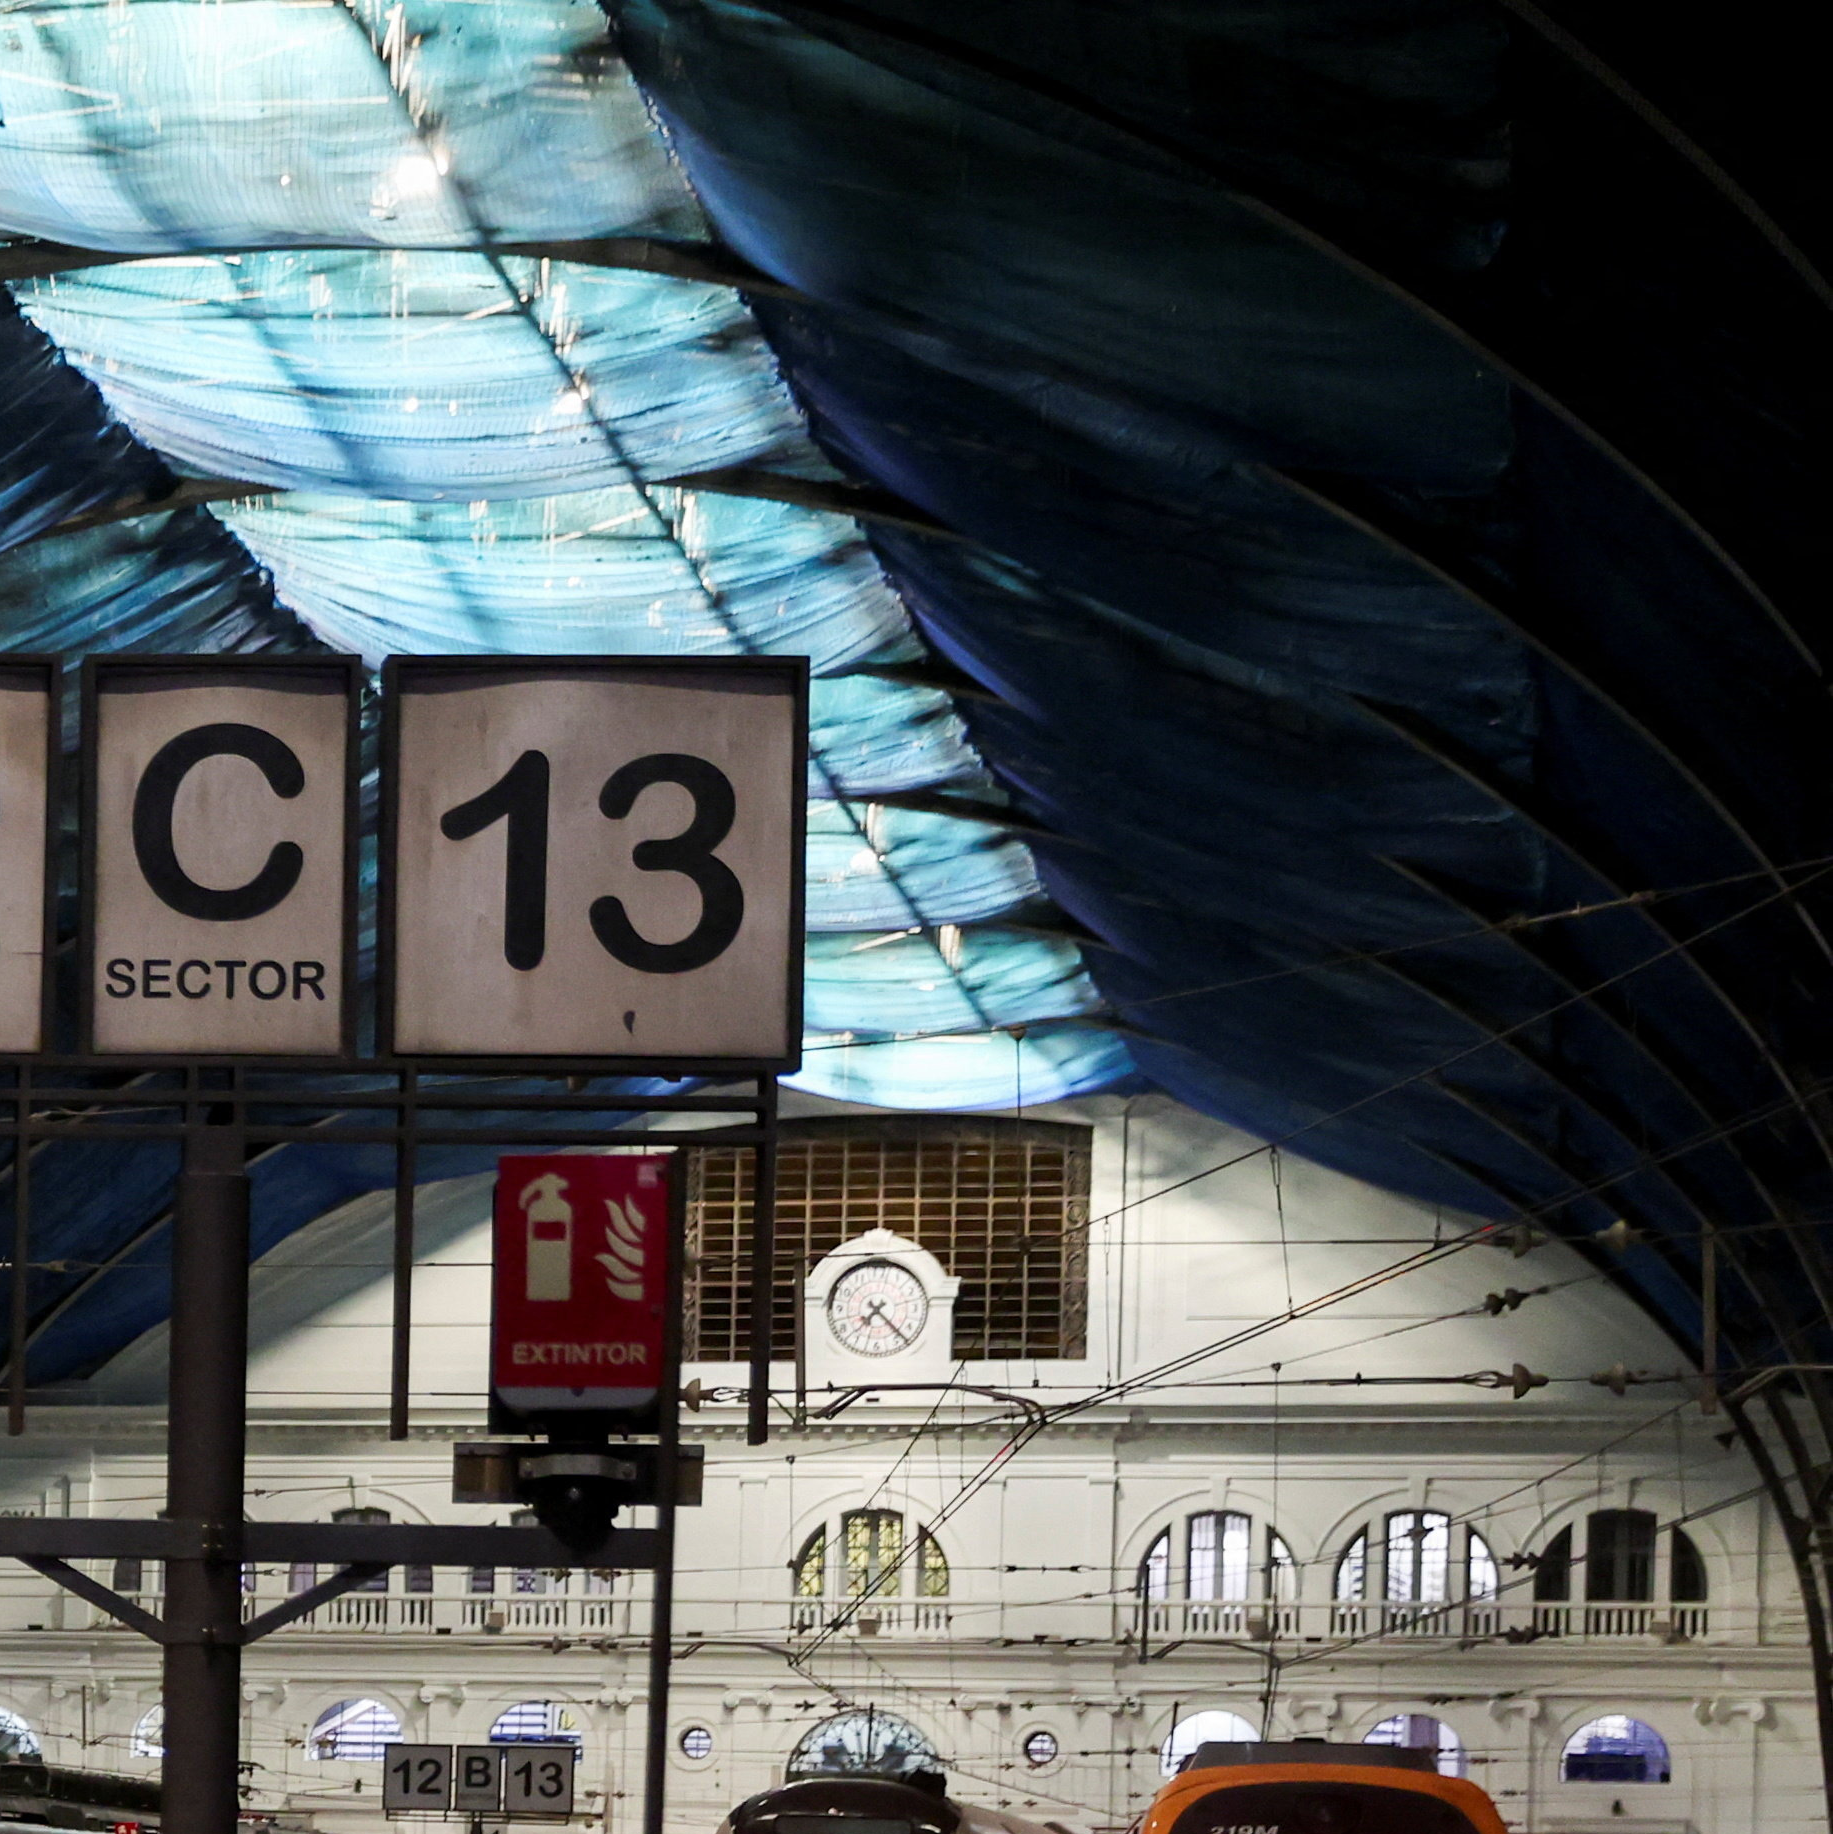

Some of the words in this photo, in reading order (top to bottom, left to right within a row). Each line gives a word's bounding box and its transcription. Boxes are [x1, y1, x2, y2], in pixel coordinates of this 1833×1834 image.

[132, 722, 305, 922] C
[439, 749, 745, 975] 13
[105, 957, 326, 1002] SECTOR
[512, 1341, 647, 1365] EXTINTOR
[392, 1758, 443, 1794] 12
[465, 1756, 492, 1788] B
[514, 1760, 564, 1798] 13
